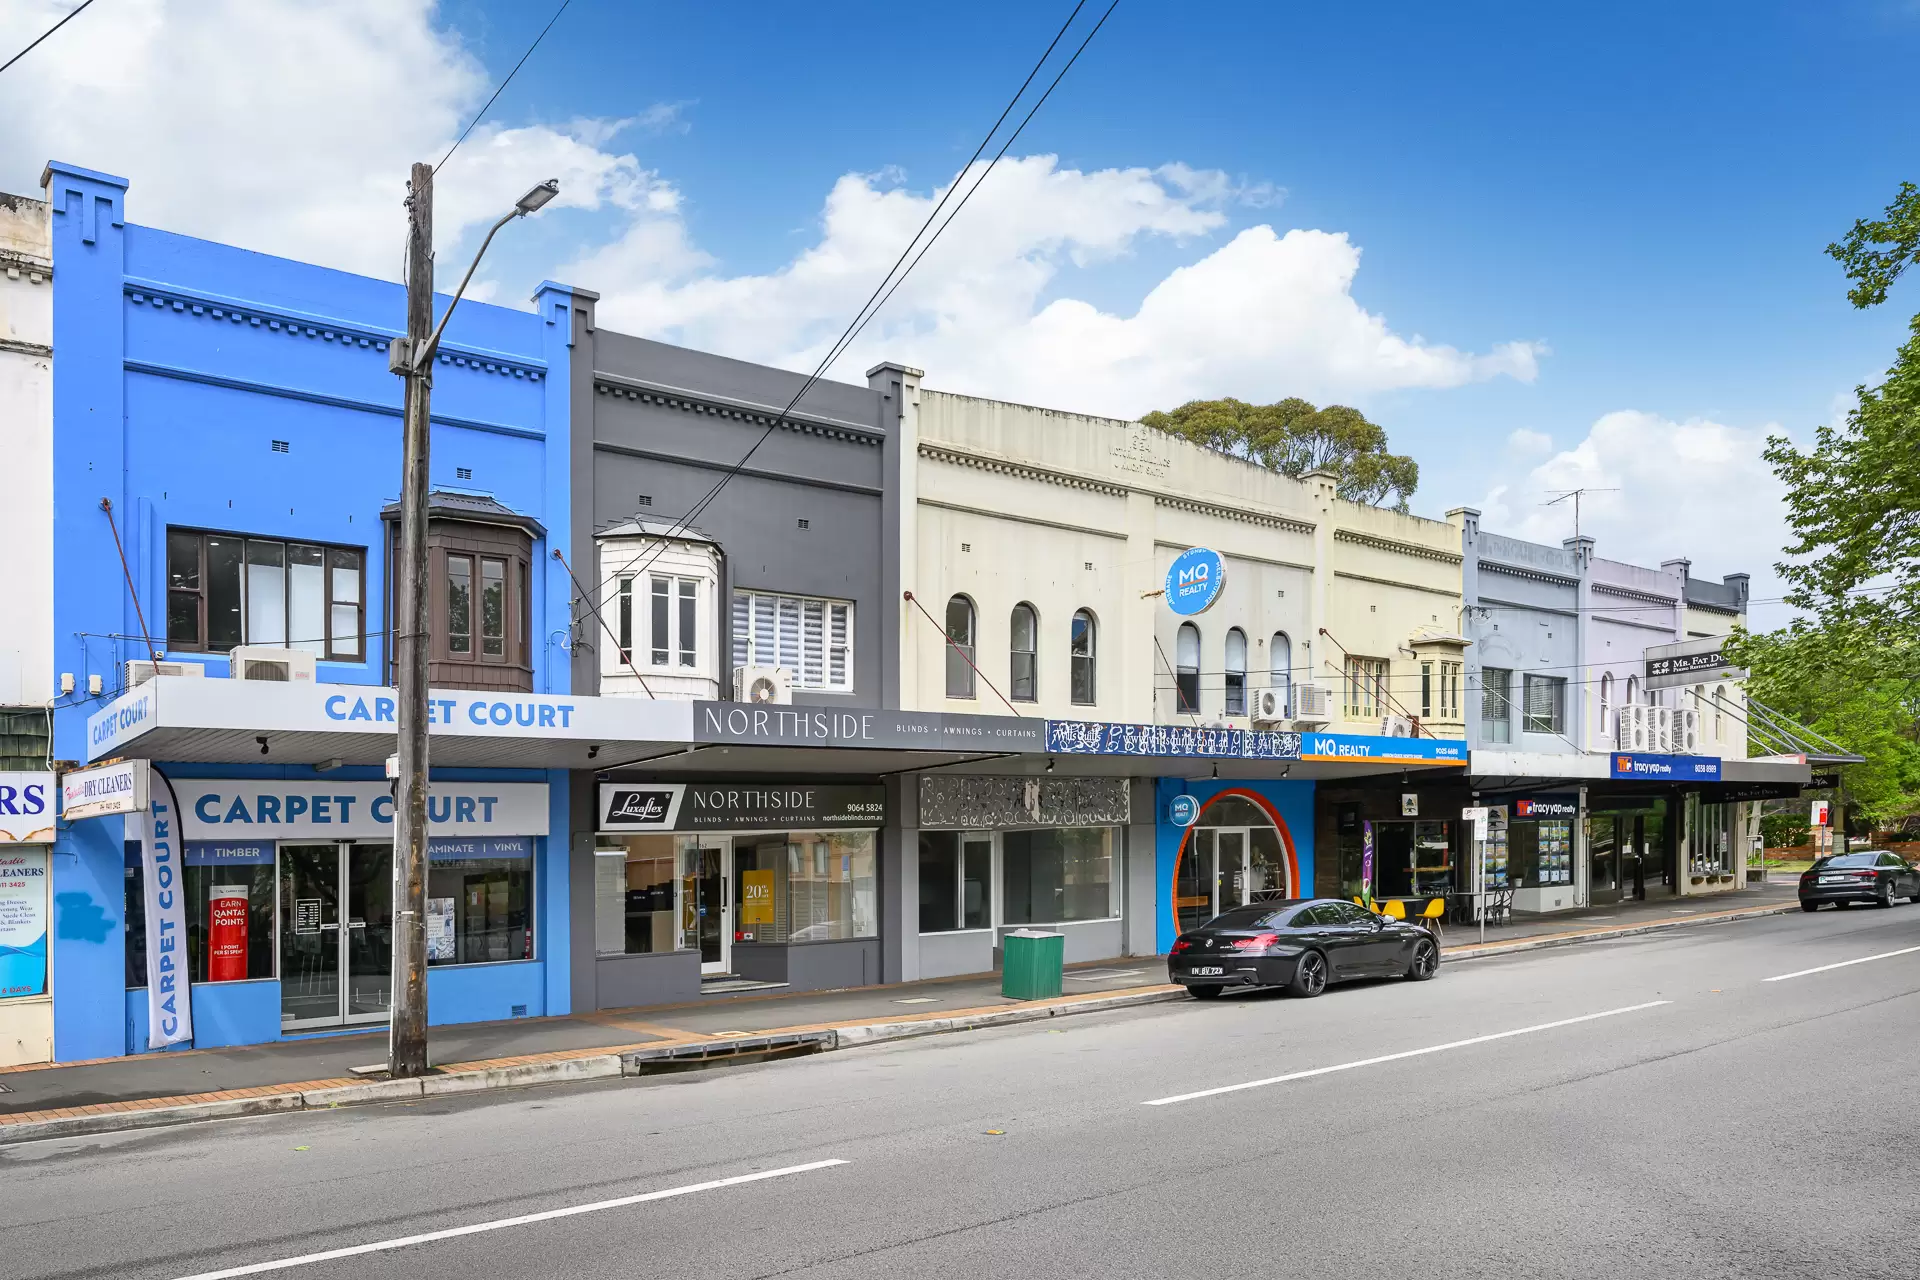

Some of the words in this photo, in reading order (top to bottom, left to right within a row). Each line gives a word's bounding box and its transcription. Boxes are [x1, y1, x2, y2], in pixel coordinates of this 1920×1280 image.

[1179, 563, 1208, 585] MQ
[1179, 582, 1208, 598] REALTY
[94, 712, 118, 746] CARPET
[120, 696, 148, 730] COURT
[325, 695, 456, 724] CARET
[468, 702, 574, 728] COURT
[706, 708, 874, 740] NORTHSIDE
[896, 724, 928, 734] BLINDS
[944, 727, 982, 736] AWNINGS
[996, 729, 1036, 738] CURTAINS
[1314, 738, 1336, 757] MQ
[1339, 744, 1370, 756] REALTY
[1634, 761, 1648, 773] tracy
[1649, 764, 1660, 774] yap
[84, 780, 98, 798] DRY
[98, 772, 132, 795] CLEANERS
[195, 794, 356, 824] CARPET
[370, 796, 498, 824] CURT
[612, 793, 663, 820] Luxaflex
[694, 790, 815, 808] NORTHSIDE
[847, 804, 864, 812] 9064
[866, 804, 883, 812] 5824
[1533, 802, 1549, 814] tracy
[1550, 803, 1562, 815] yap
[1562, 805, 1576, 814] realty
[152, 800, 173, 910] COURT
[215, 848, 260, 857] TIMBER
[428, 844, 474, 853] AMINATE
[494, 843, 523, 851] VINYL
[214, 909, 245, 918] QANTAS
[160, 918, 178, 1036] CARPET
